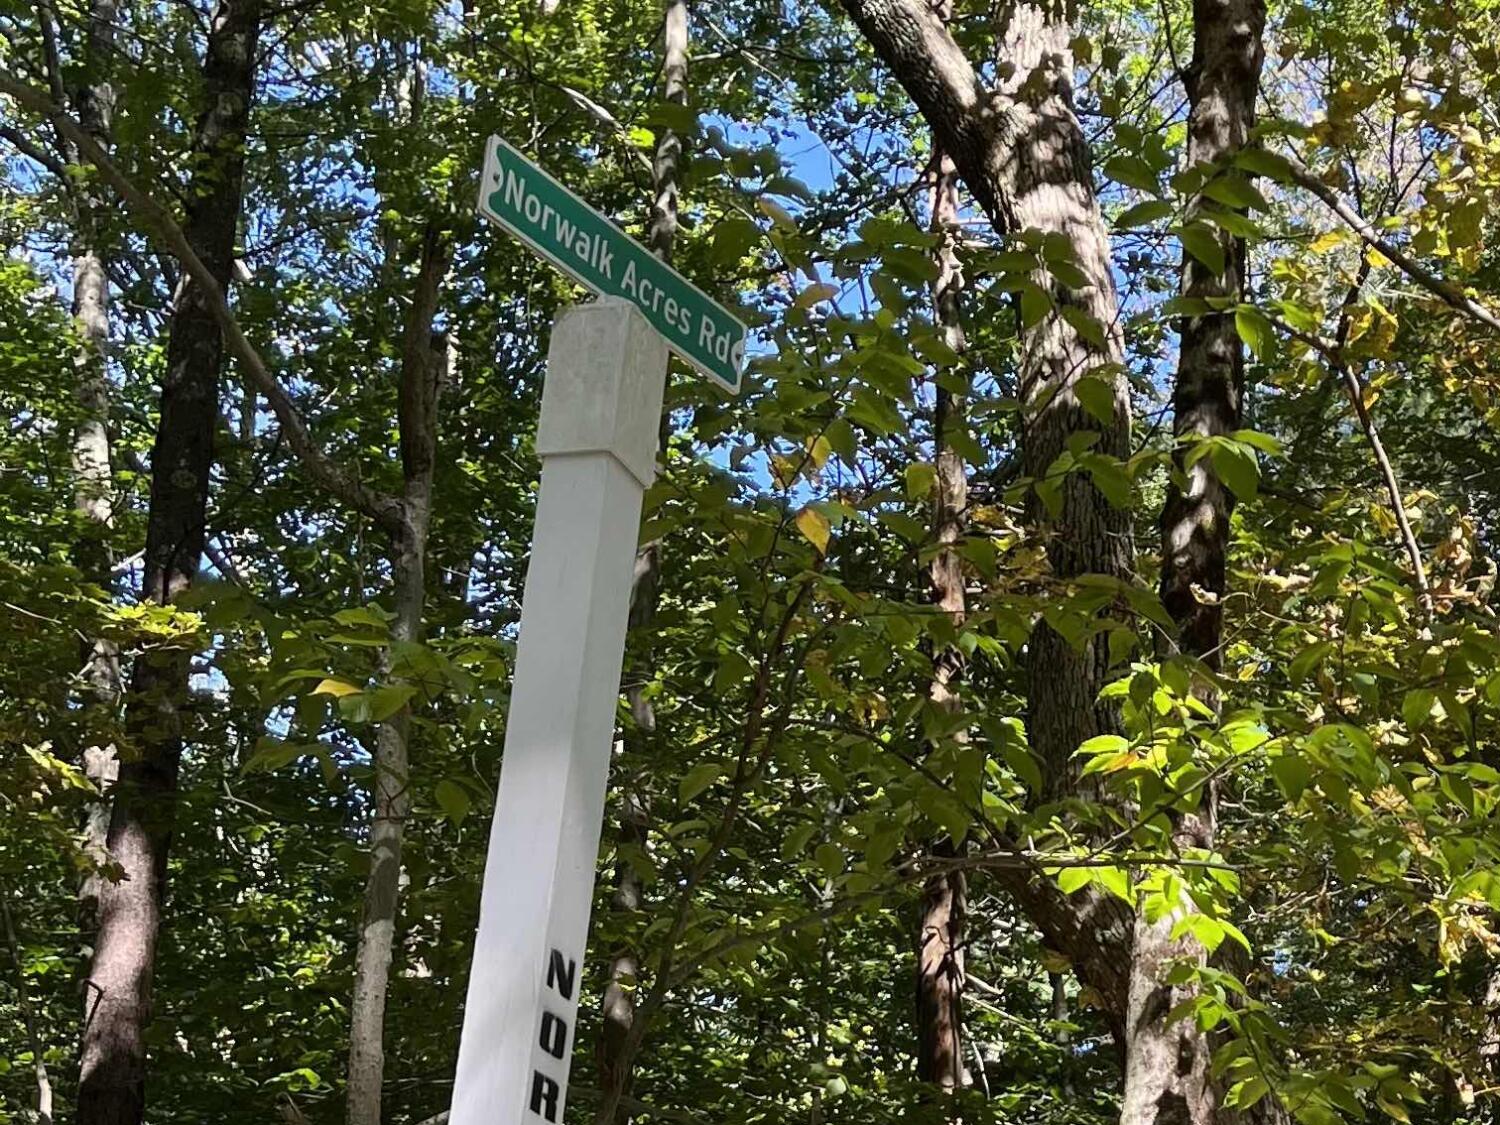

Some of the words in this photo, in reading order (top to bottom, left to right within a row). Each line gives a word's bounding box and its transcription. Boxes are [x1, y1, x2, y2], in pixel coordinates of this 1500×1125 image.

[503, 167, 614, 280] Norwalk
[620, 260, 693, 336] Acres
[698, 314, 731, 365] Rd
